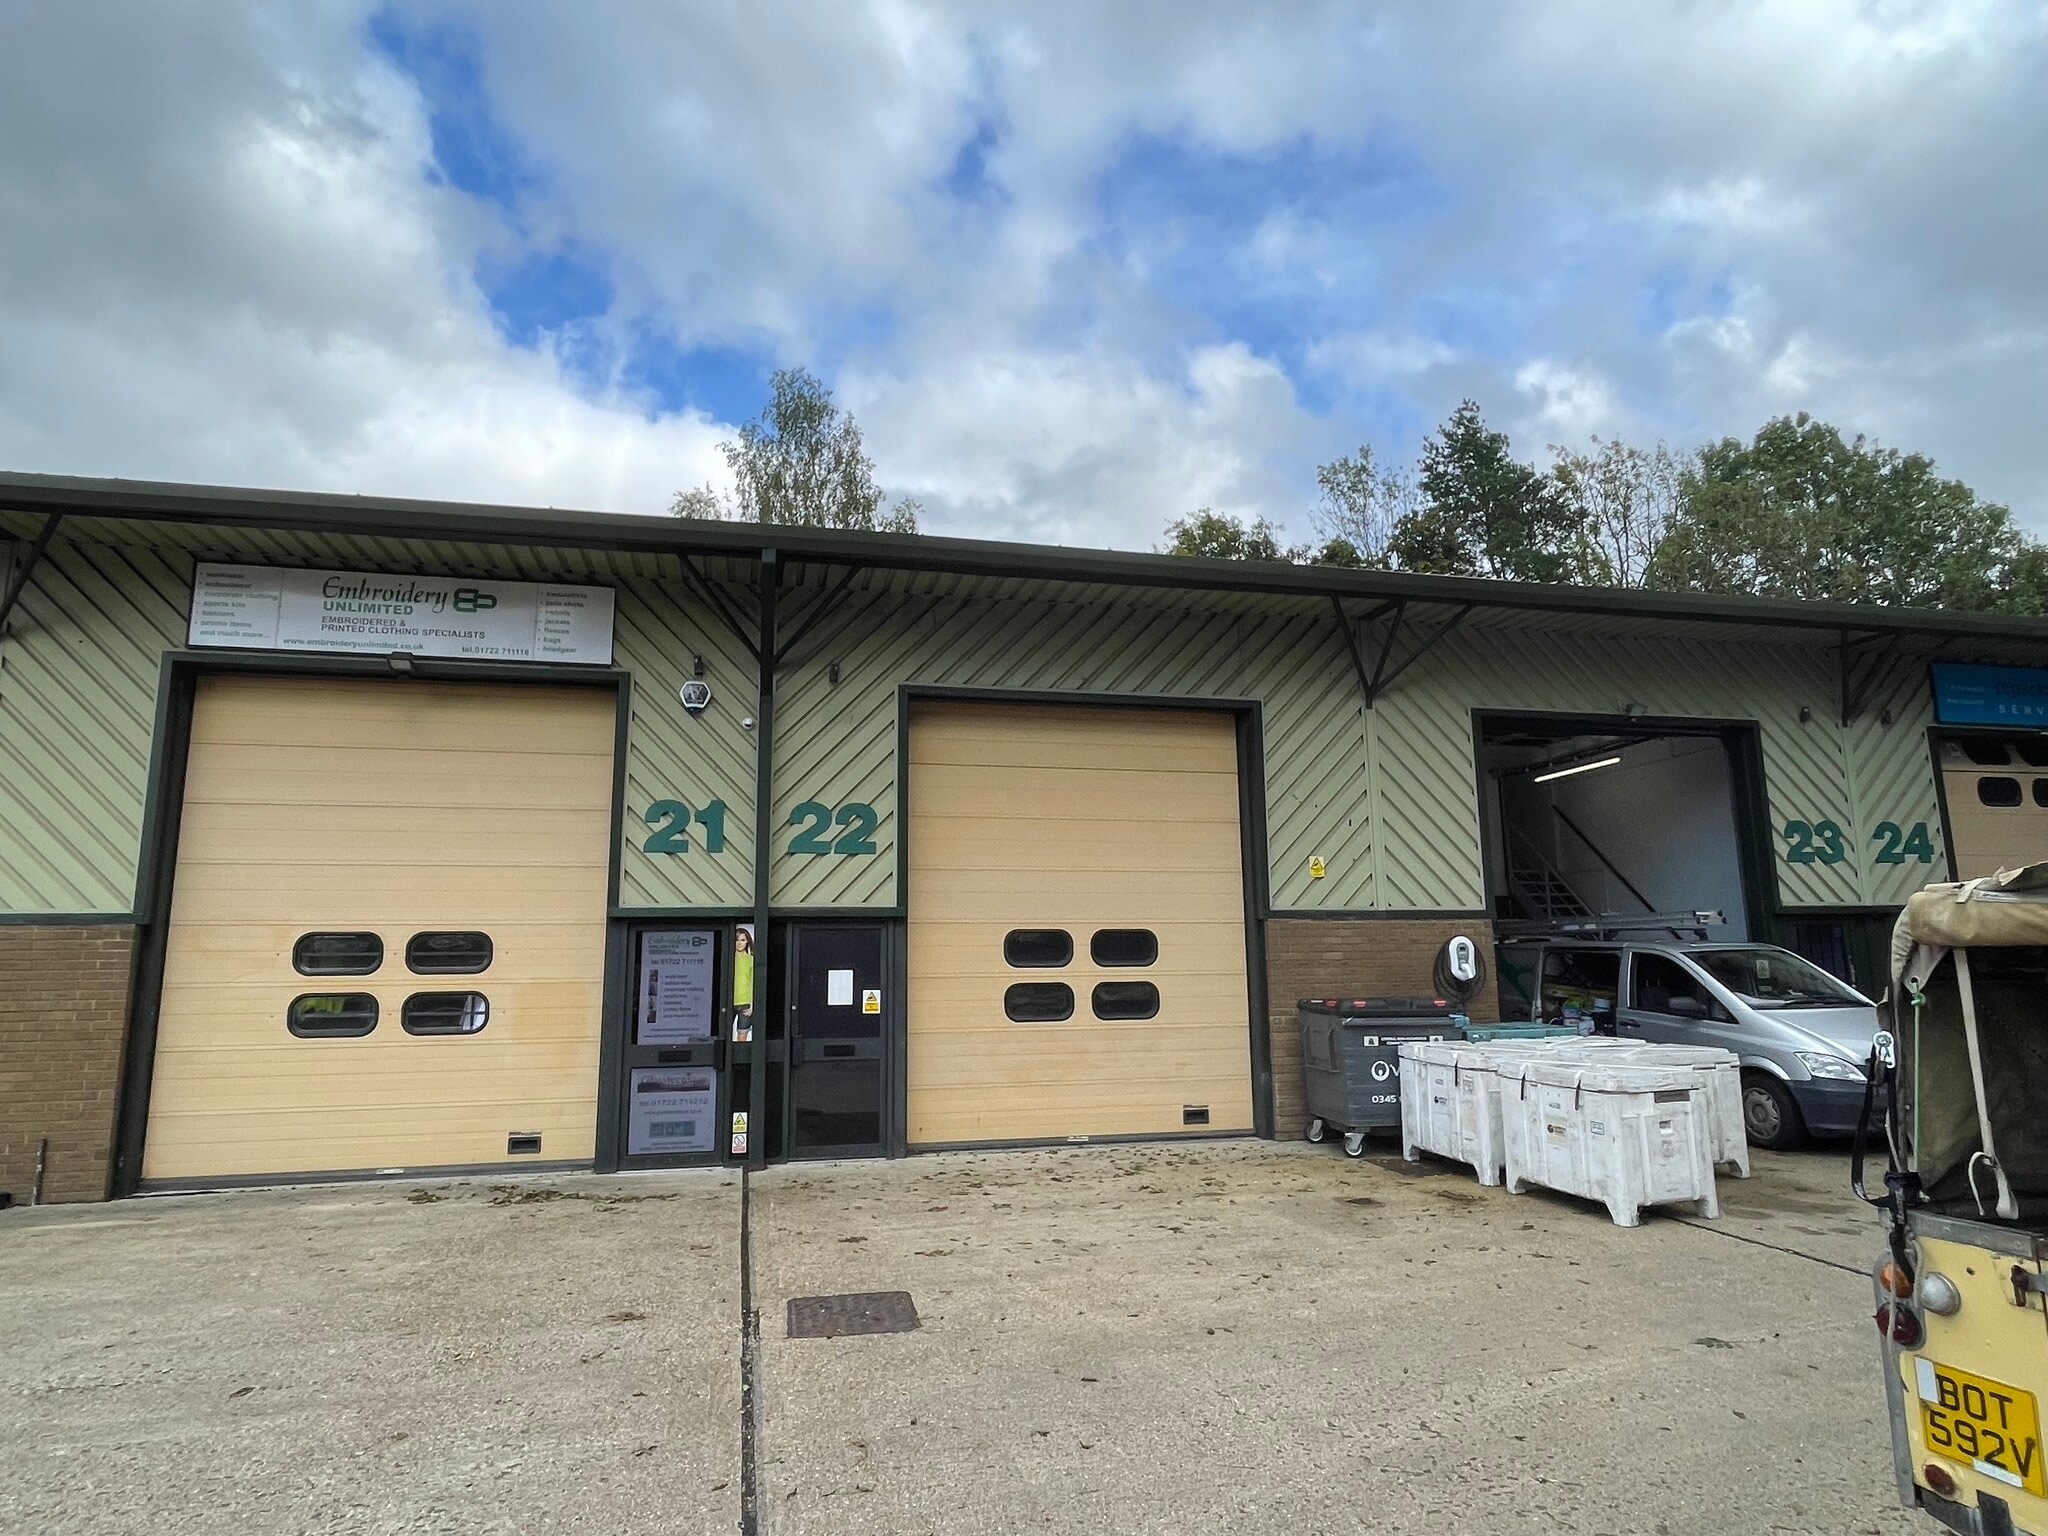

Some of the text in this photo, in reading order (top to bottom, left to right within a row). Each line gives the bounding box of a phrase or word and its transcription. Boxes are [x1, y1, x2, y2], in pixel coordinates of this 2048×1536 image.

[322, 576, 448, 614] Embroidery
[323, 600, 414, 615] UNLIMITED
[321, 615, 406, 627] EMBROIDERED &
[321, 624, 485, 639] PRINTED CLOTHING SPECIALISTS
[283, 638, 424, 650] www.embroideryunlimited.co.uk
[643, 799, 726, 854] 21
[787, 801, 878, 855] 22
[1784, 819, 1845, 865] 23
[1873, 821, 1934, 865] 24
[1371, 1095, 1397, 1103] 0345
[1936, 1373, 2013, 1430] BOT
[1929, 1409, 2036, 1478] 592V
